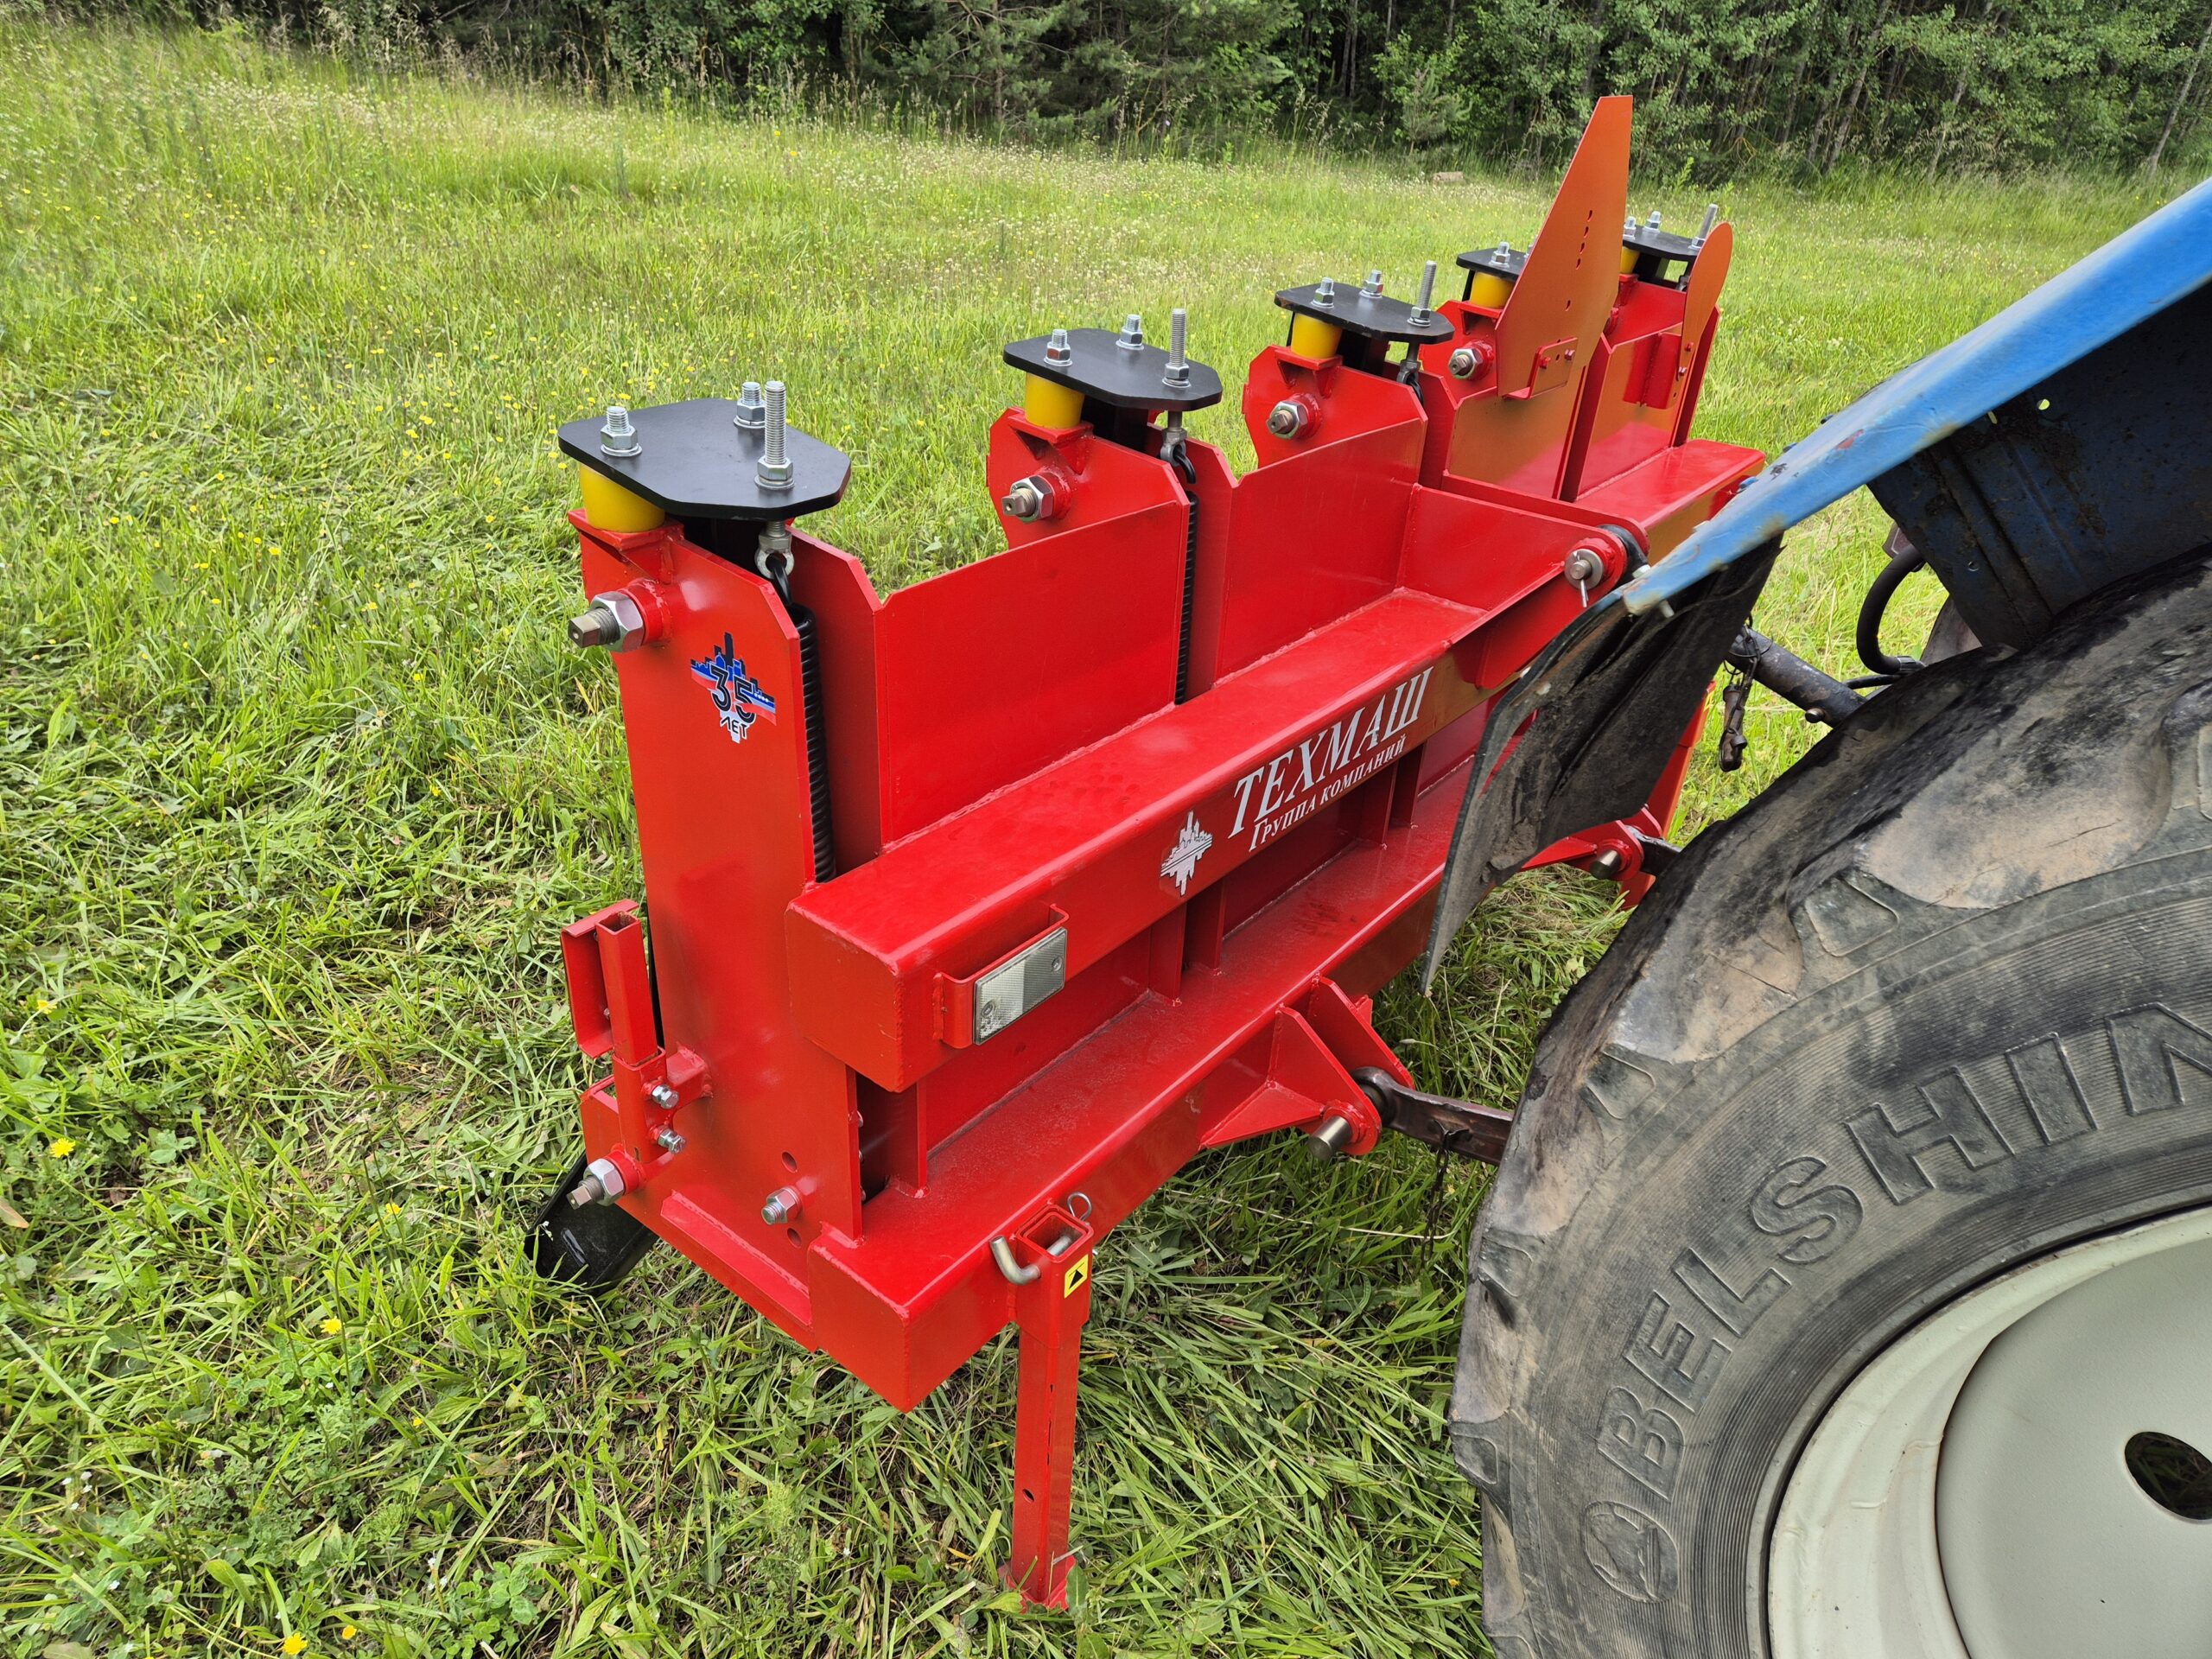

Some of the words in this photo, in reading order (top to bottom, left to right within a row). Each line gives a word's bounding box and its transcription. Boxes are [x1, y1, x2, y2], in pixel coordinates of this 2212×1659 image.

[709, 664, 756, 724] 35
[721, 716, 747, 739] ЛЕТ
[1227, 666, 1433, 839] ТЕХМАШ
